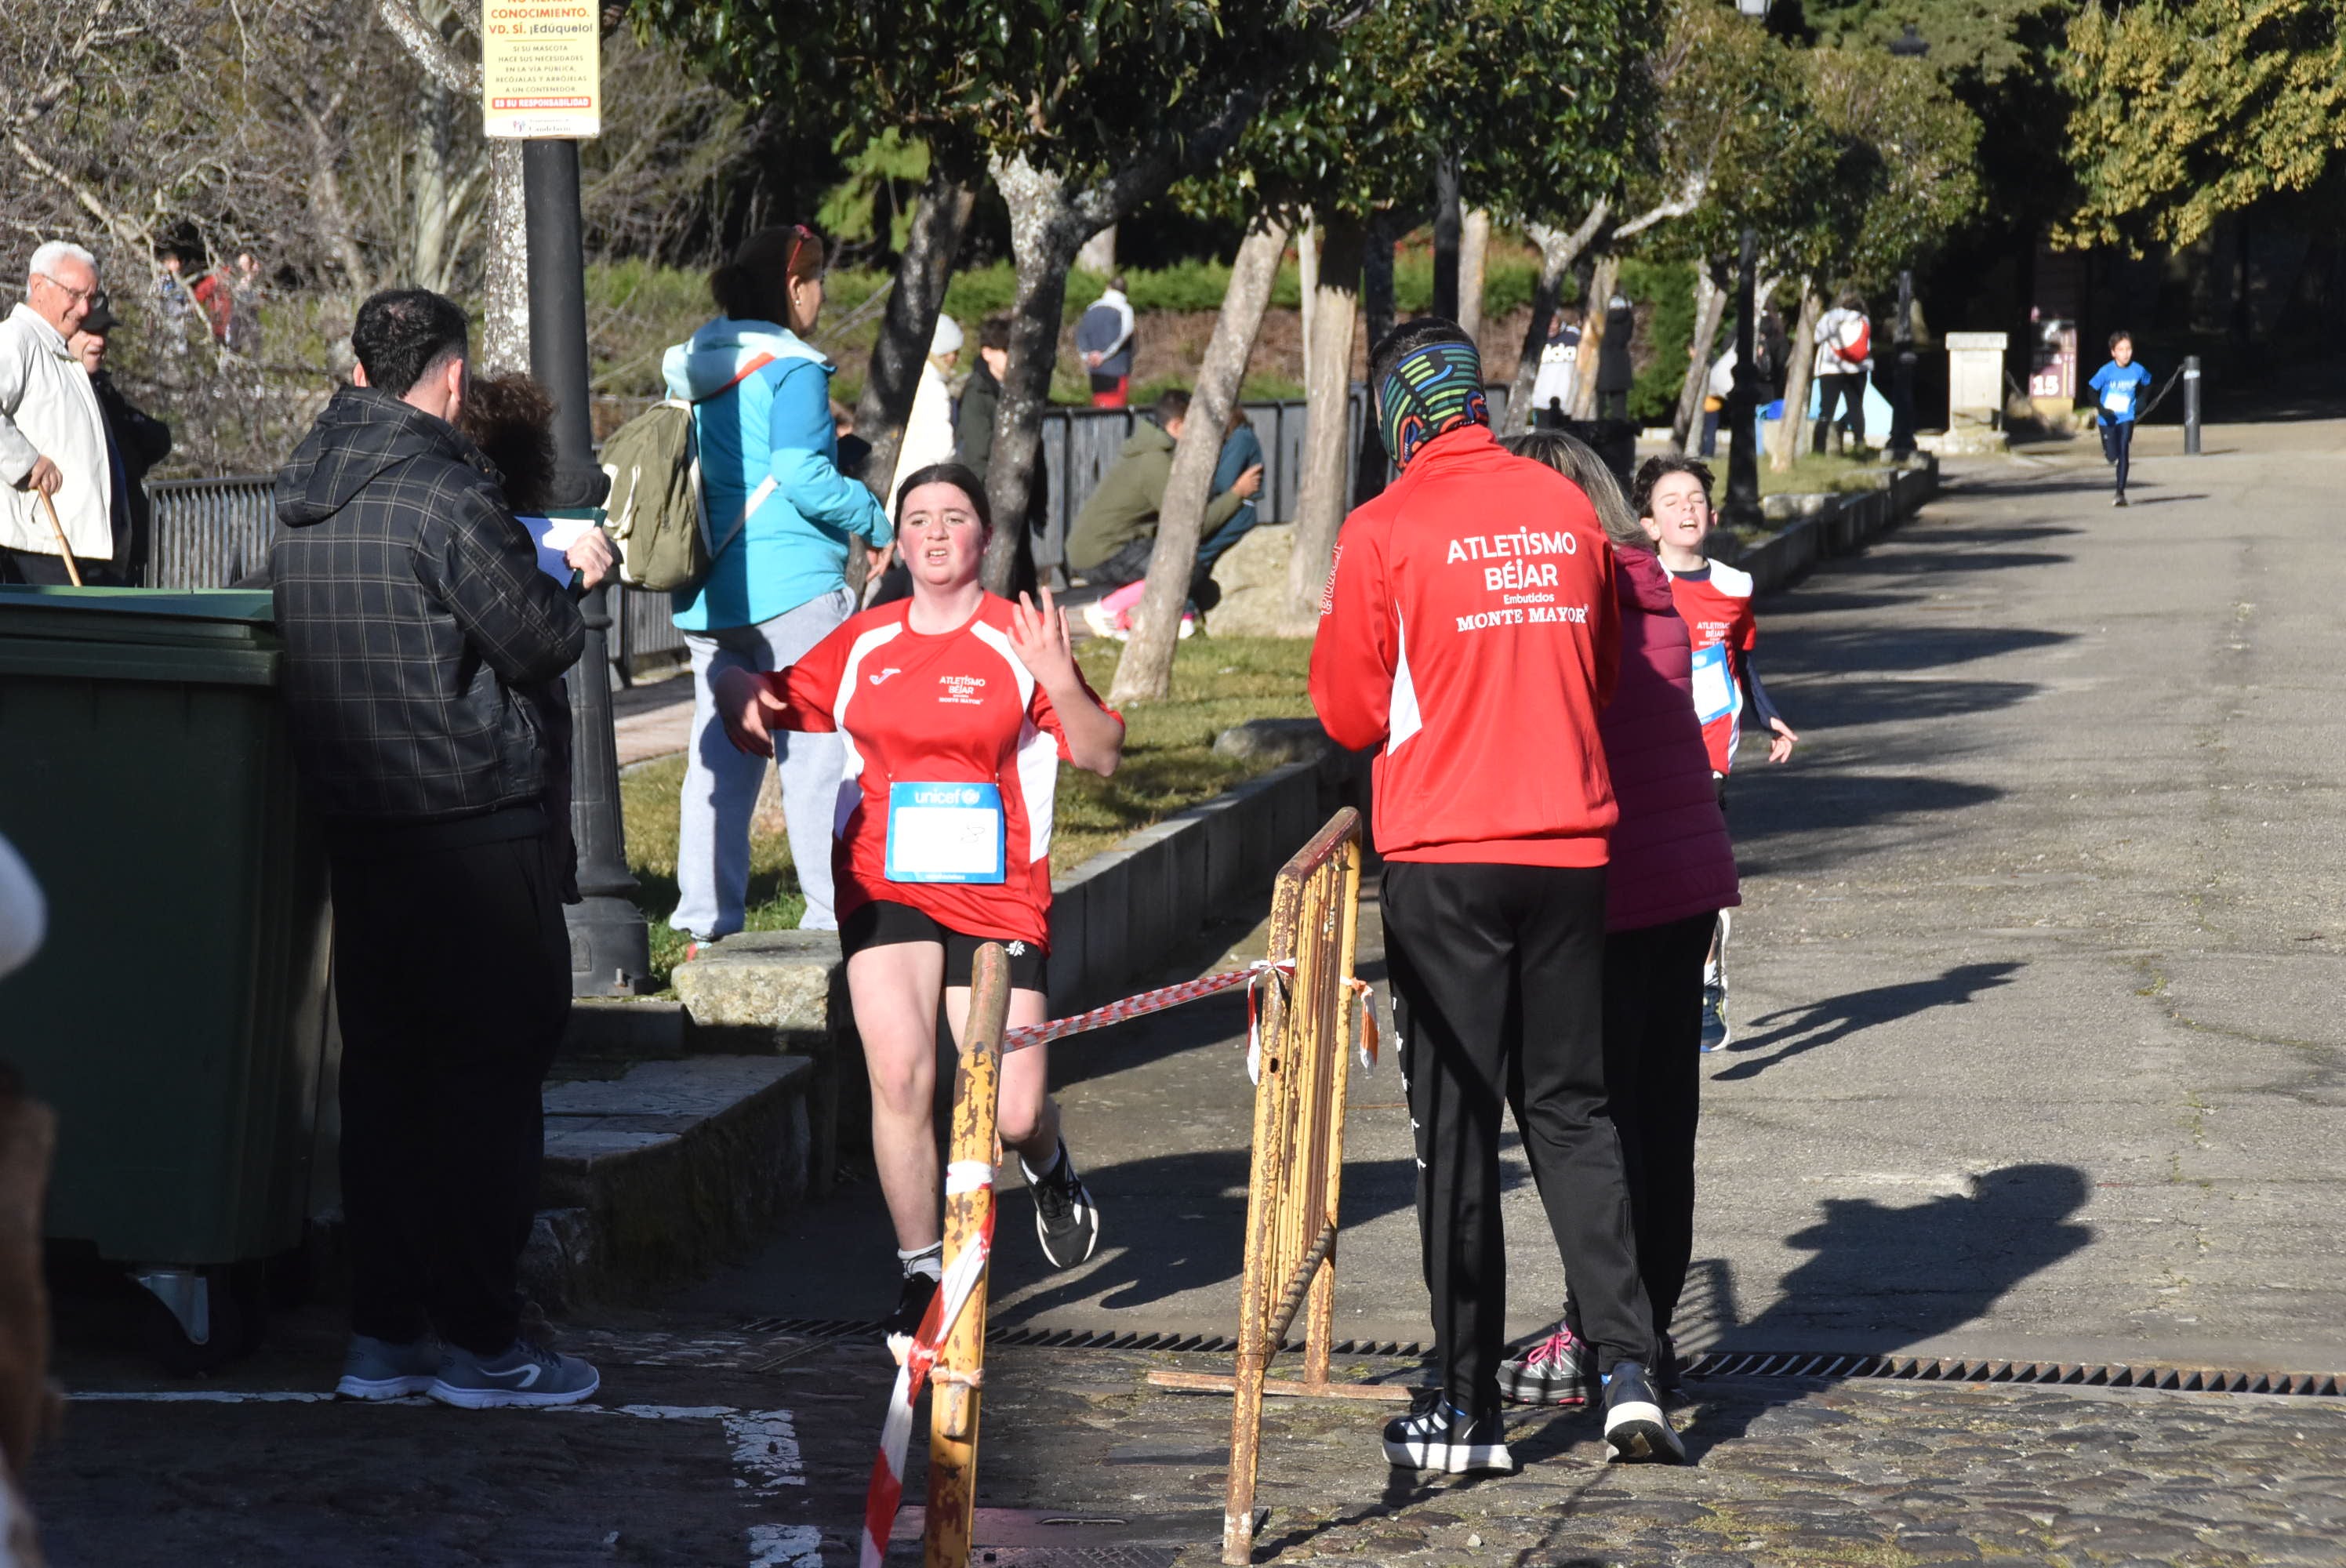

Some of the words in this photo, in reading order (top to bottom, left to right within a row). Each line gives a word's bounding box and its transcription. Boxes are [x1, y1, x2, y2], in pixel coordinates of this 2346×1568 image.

[491, 7, 590, 19] CONOCIMIENTO.
[488, 24, 509, 34] VD.
[530, 23, 593, 35] ¡Edúquelo!
[518, 98, 589, 107] RESPONSABILIDAD
[2033, 375, 2059, 395] 15
[1503, 592, 1555, 604] Embutidos
[1456, 608, 1523, 632] MONTE
[915, 788, 961, 804] unicef
